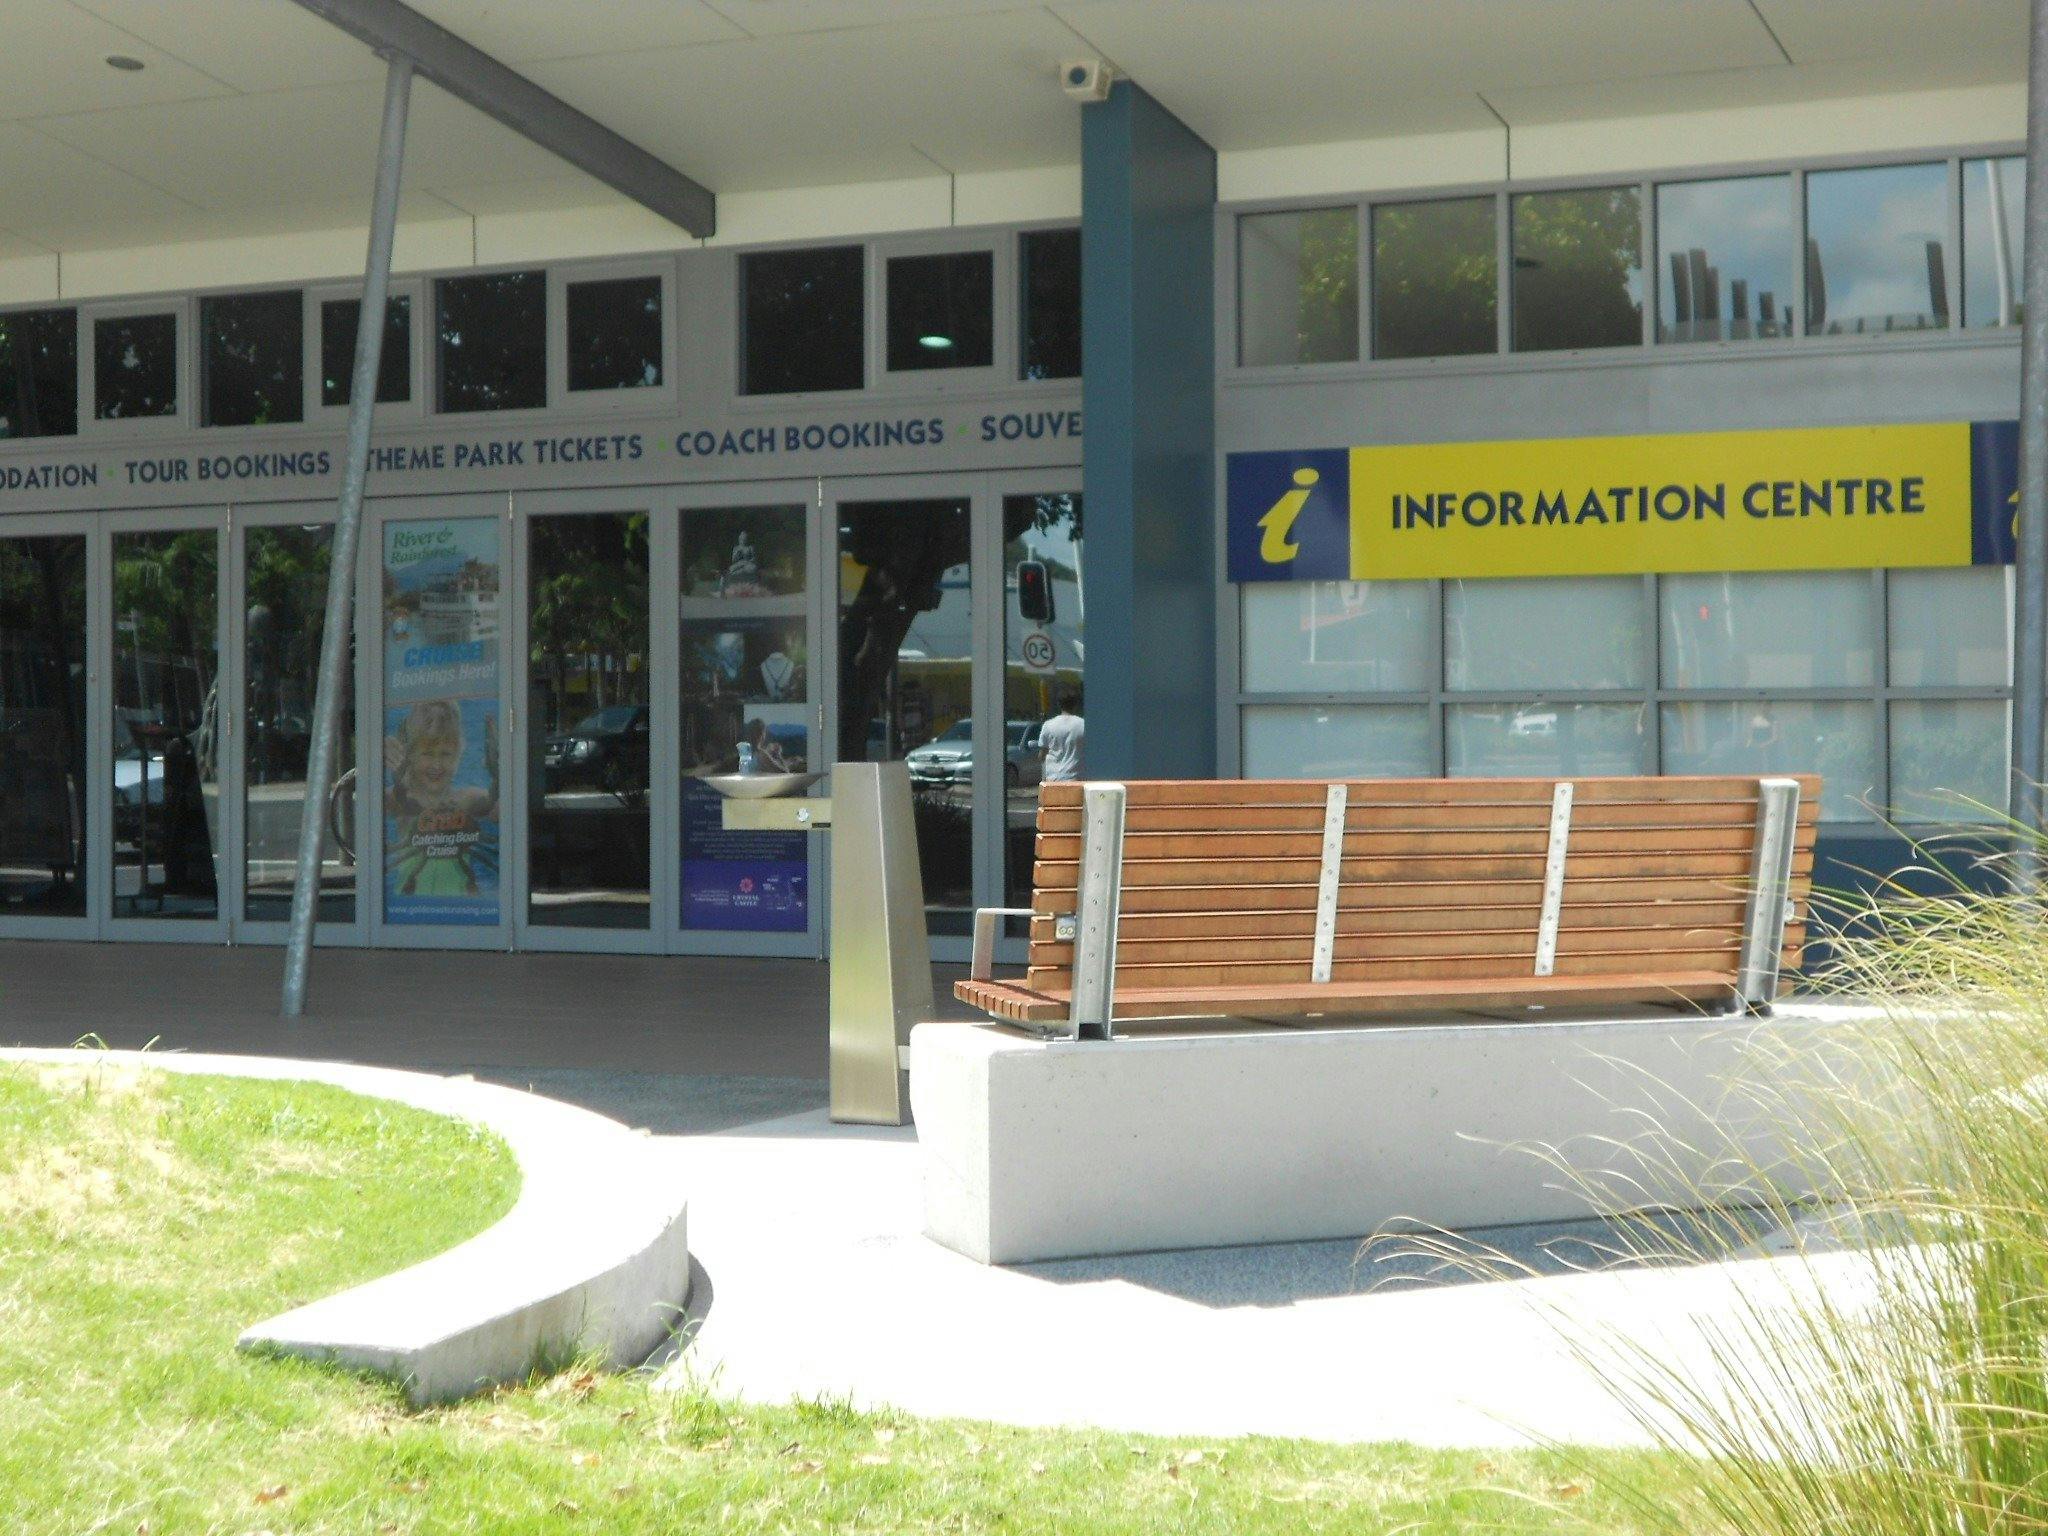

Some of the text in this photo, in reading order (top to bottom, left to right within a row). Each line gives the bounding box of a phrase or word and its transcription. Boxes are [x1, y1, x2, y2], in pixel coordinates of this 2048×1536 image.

[676, 418, 944, 458] COACH BOOKINGS
[981, 411, 1082, 442] SOUVE
[125, 451, 331, 484] TOUR BOOKINGS
[454, 440, 525, 468] PARK
[533, 434, 644, 464] TICKETS
[1392, 476, 1925, 530] INFORMATION CENTRE
[411, 830, 480, 846] Catching Boat
[426, 845, 459, 857] Cruise
